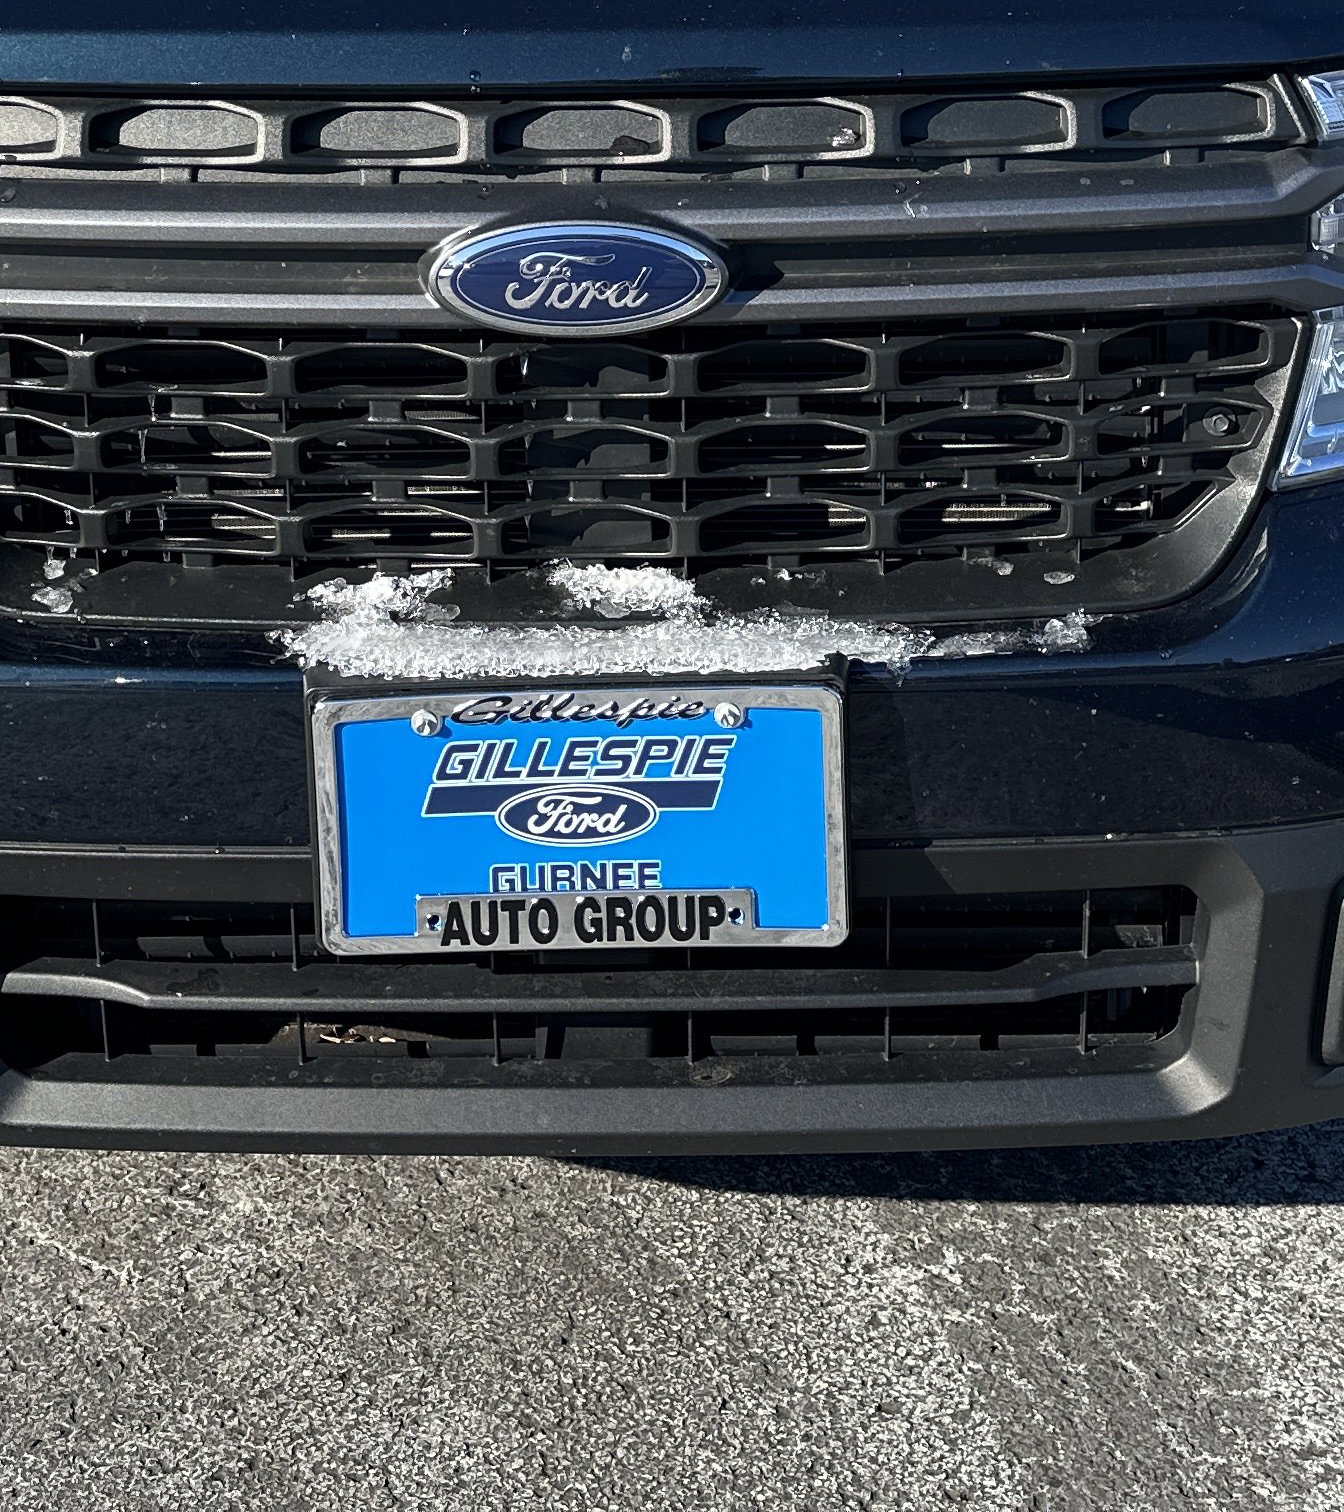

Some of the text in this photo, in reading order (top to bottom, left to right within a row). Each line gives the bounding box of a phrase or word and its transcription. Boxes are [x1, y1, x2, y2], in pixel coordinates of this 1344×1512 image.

[505, 252, 652, 309] Ford
[451, 693, 704, 730] Gillespie
[432, 734, 737, 782] GILLESPIE
[526, 796, 626, 835] Ford
[489, 860, 662, 894] GURNEE
[441, 895, 726, 946] AUTO GROUP
